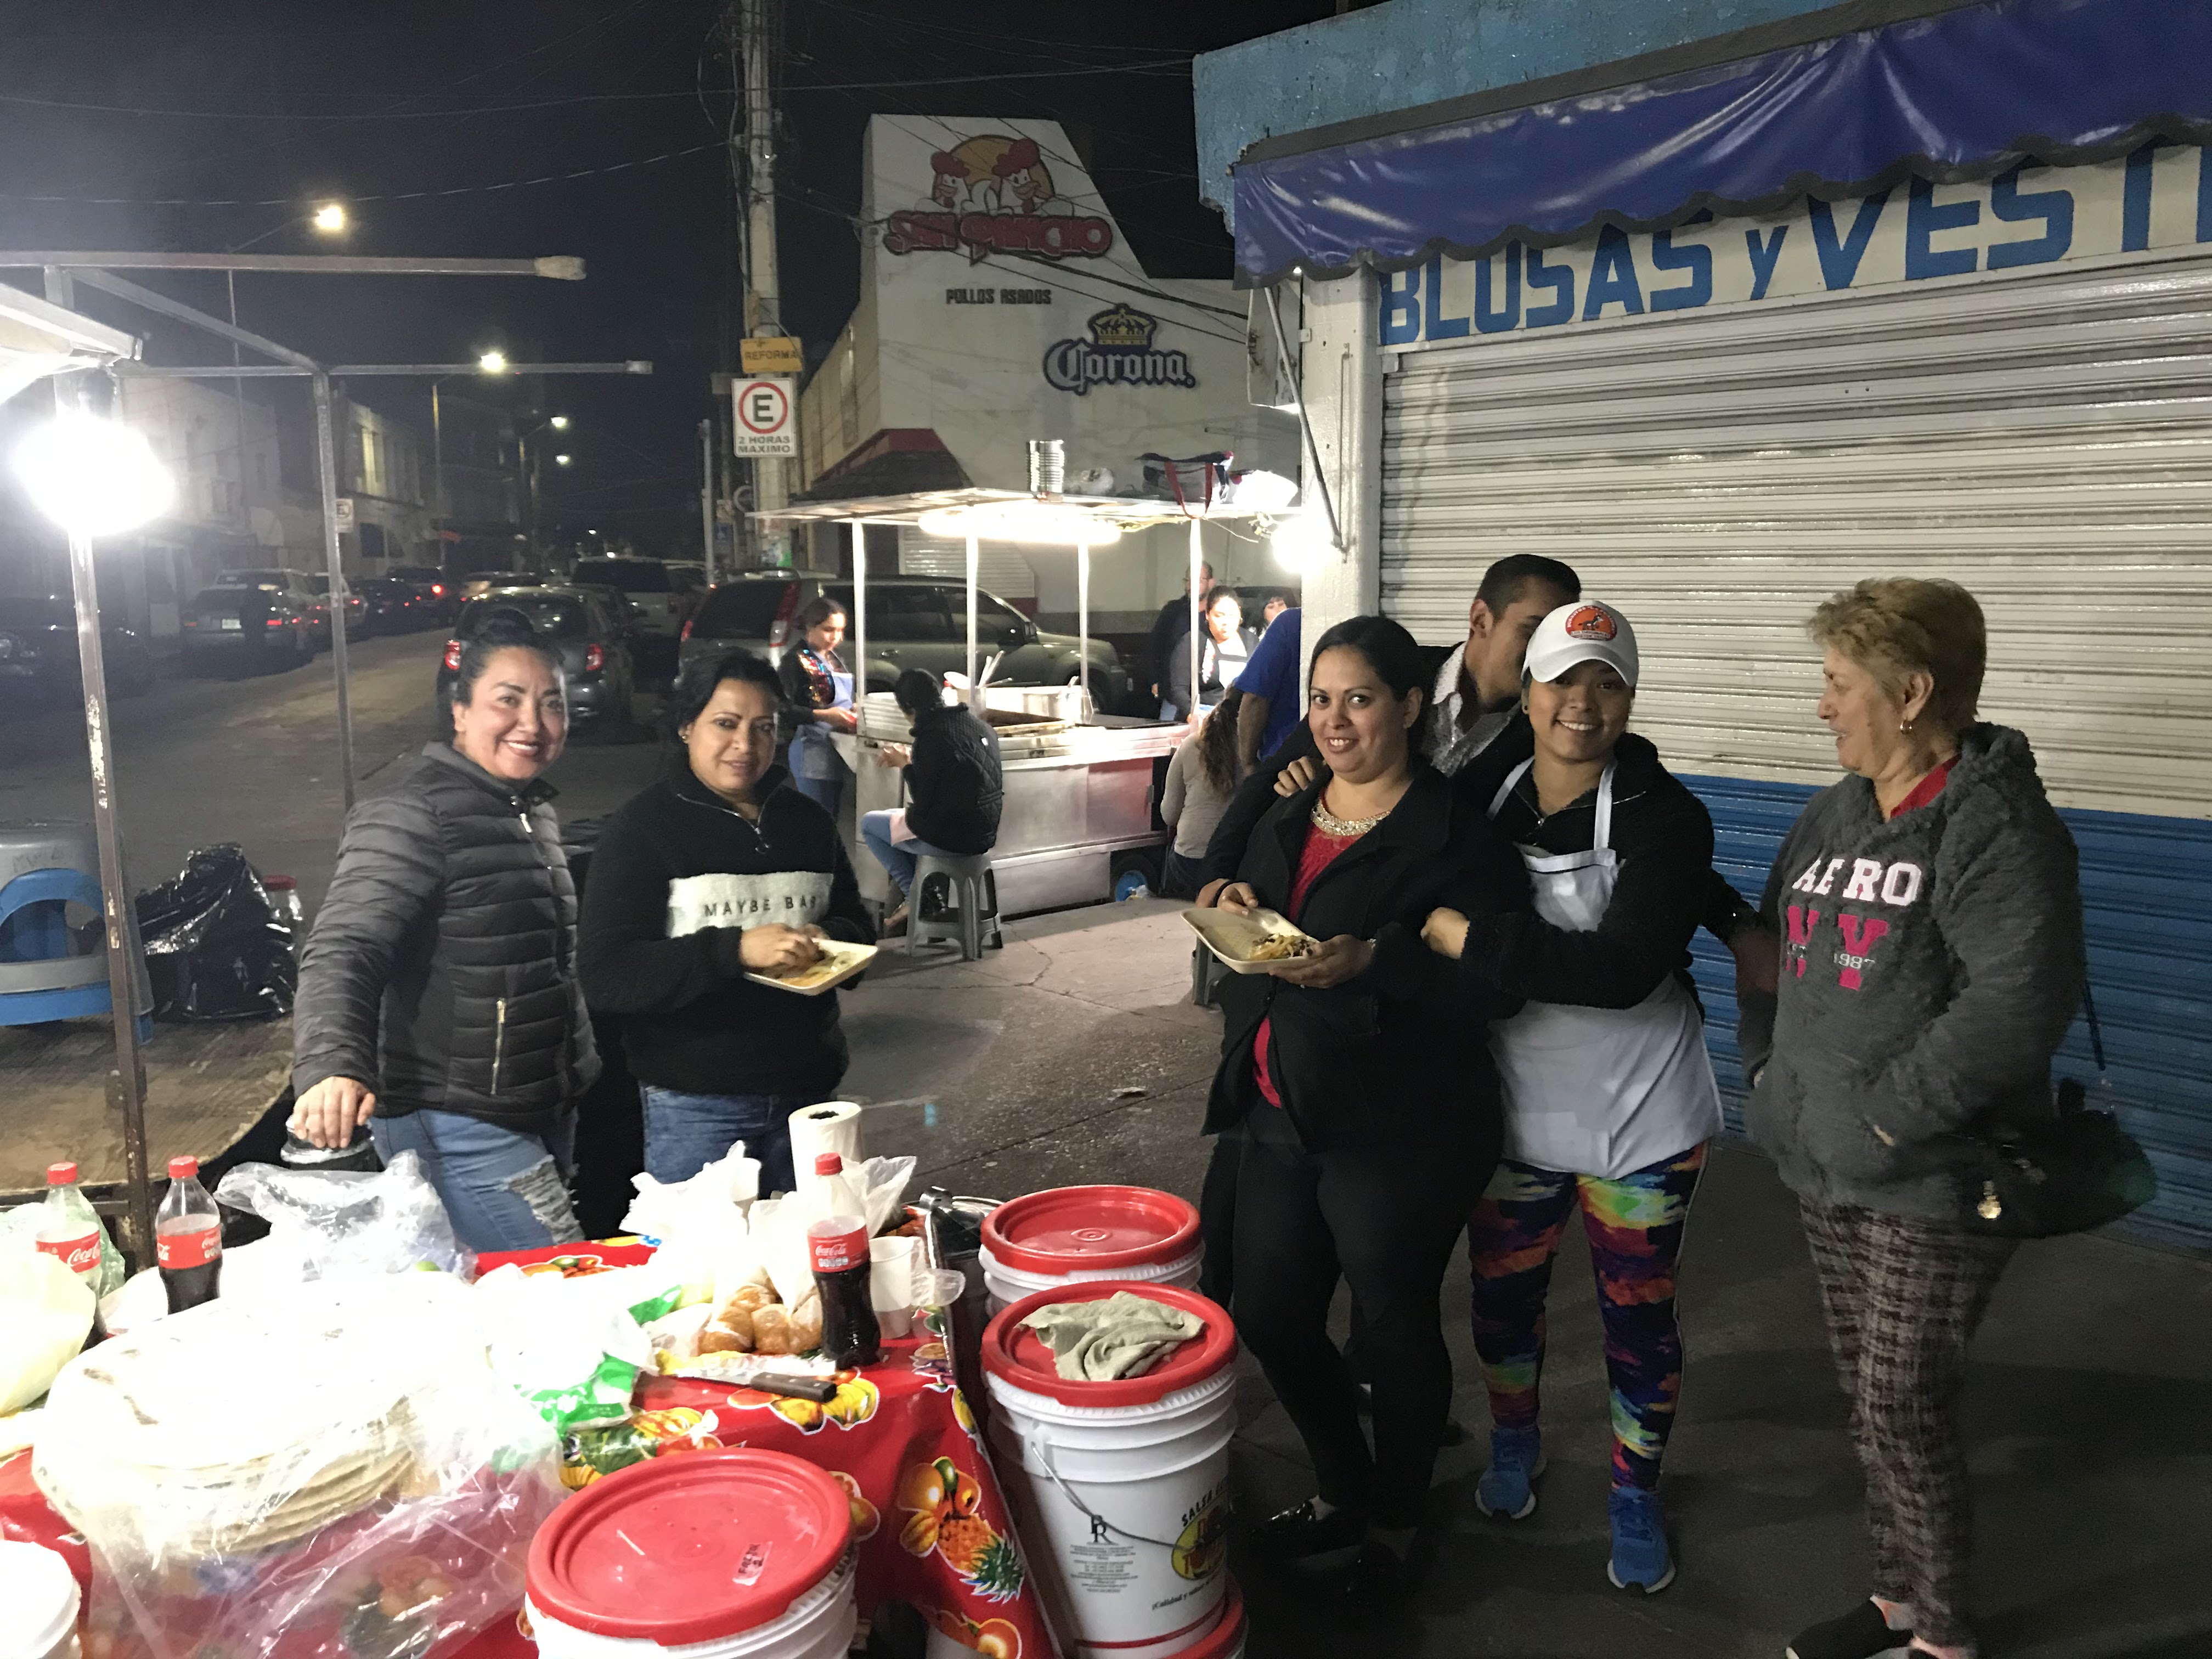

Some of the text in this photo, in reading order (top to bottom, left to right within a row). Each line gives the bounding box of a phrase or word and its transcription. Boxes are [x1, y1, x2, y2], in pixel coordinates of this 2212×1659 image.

[946, 289, 1052, 304] POLLOS ASADOS
[744, 349, 798, 360] REFORMA
[1043, 338, 1188, 395] Corona
[752, 394, 774, 422] E
[748, 436, 791, 444] HORAS
[704, 899, 771, 917] MAYBE
